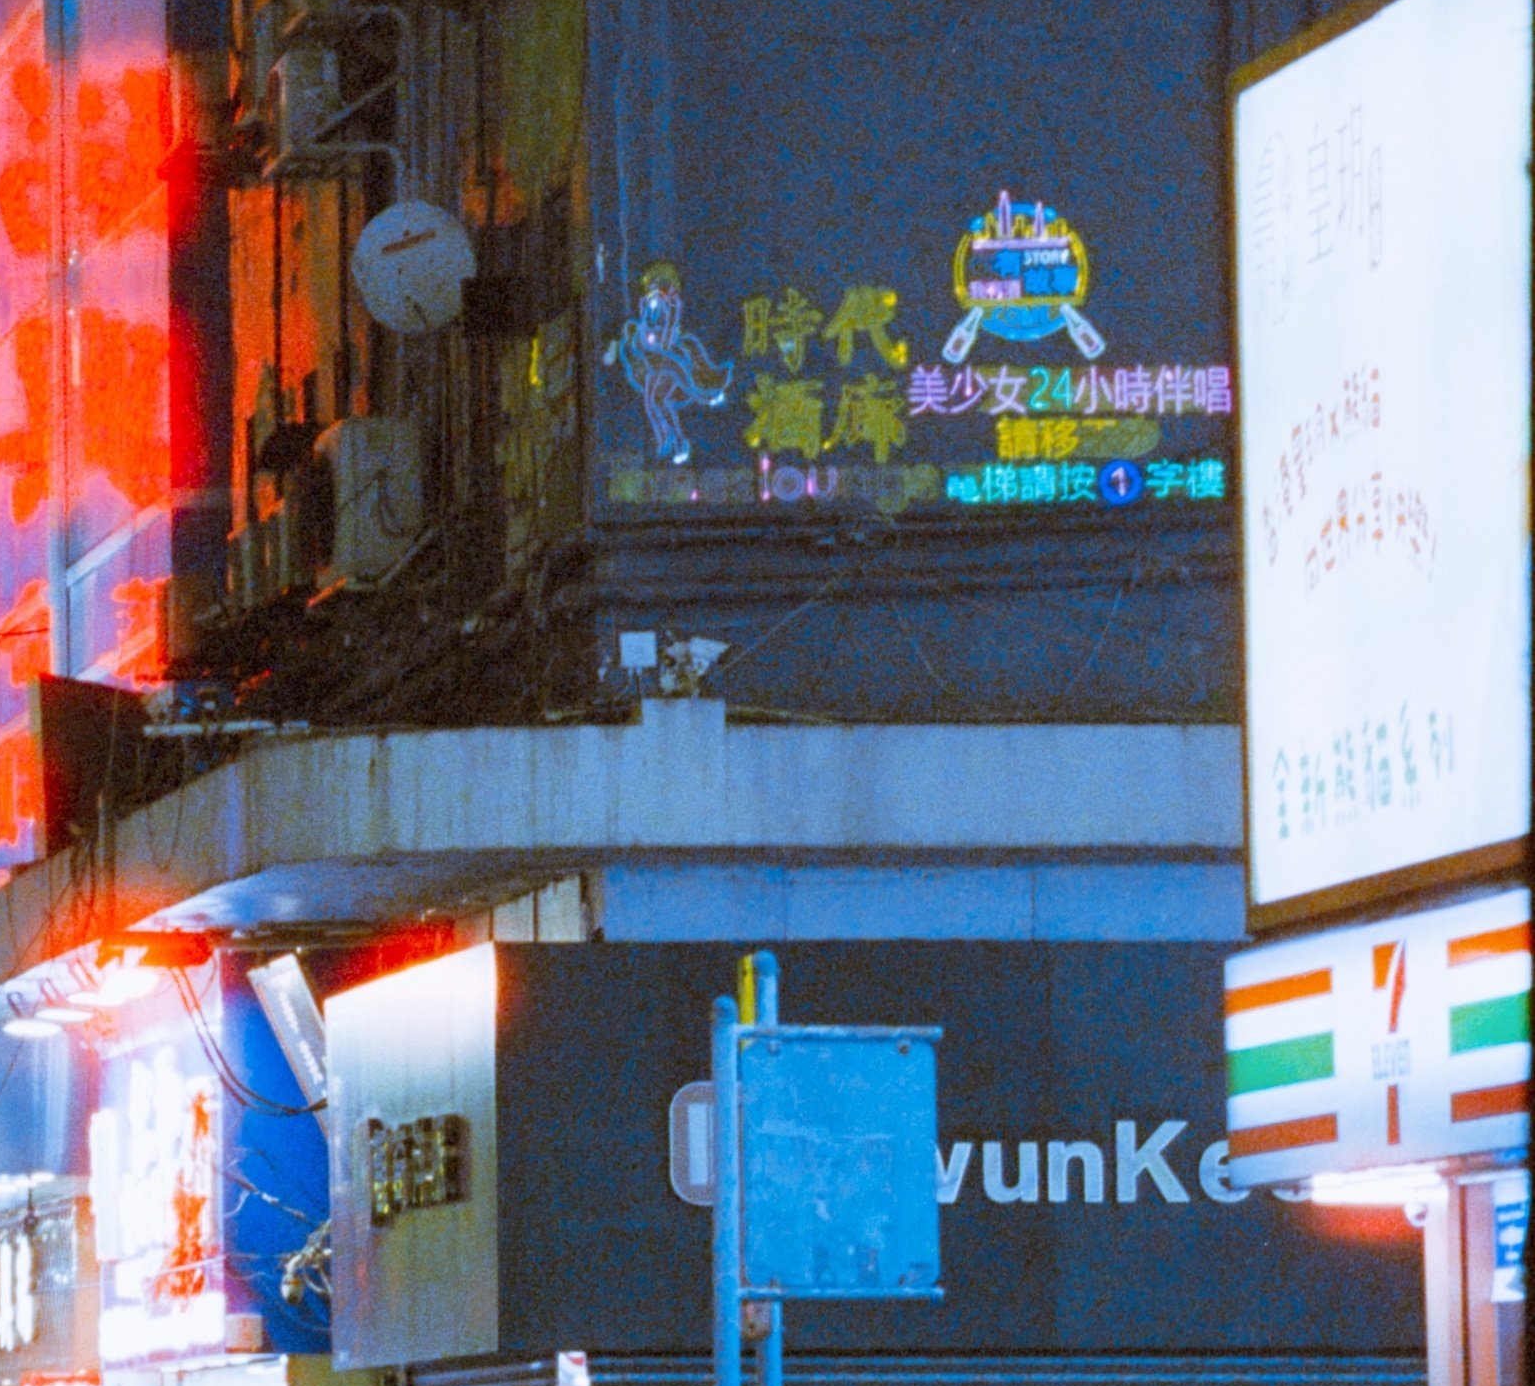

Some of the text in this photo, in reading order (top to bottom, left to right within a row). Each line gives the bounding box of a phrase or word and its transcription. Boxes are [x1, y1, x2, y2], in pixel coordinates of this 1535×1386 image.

[908, 365, 1232, 415] 美少女24小時伴唱
